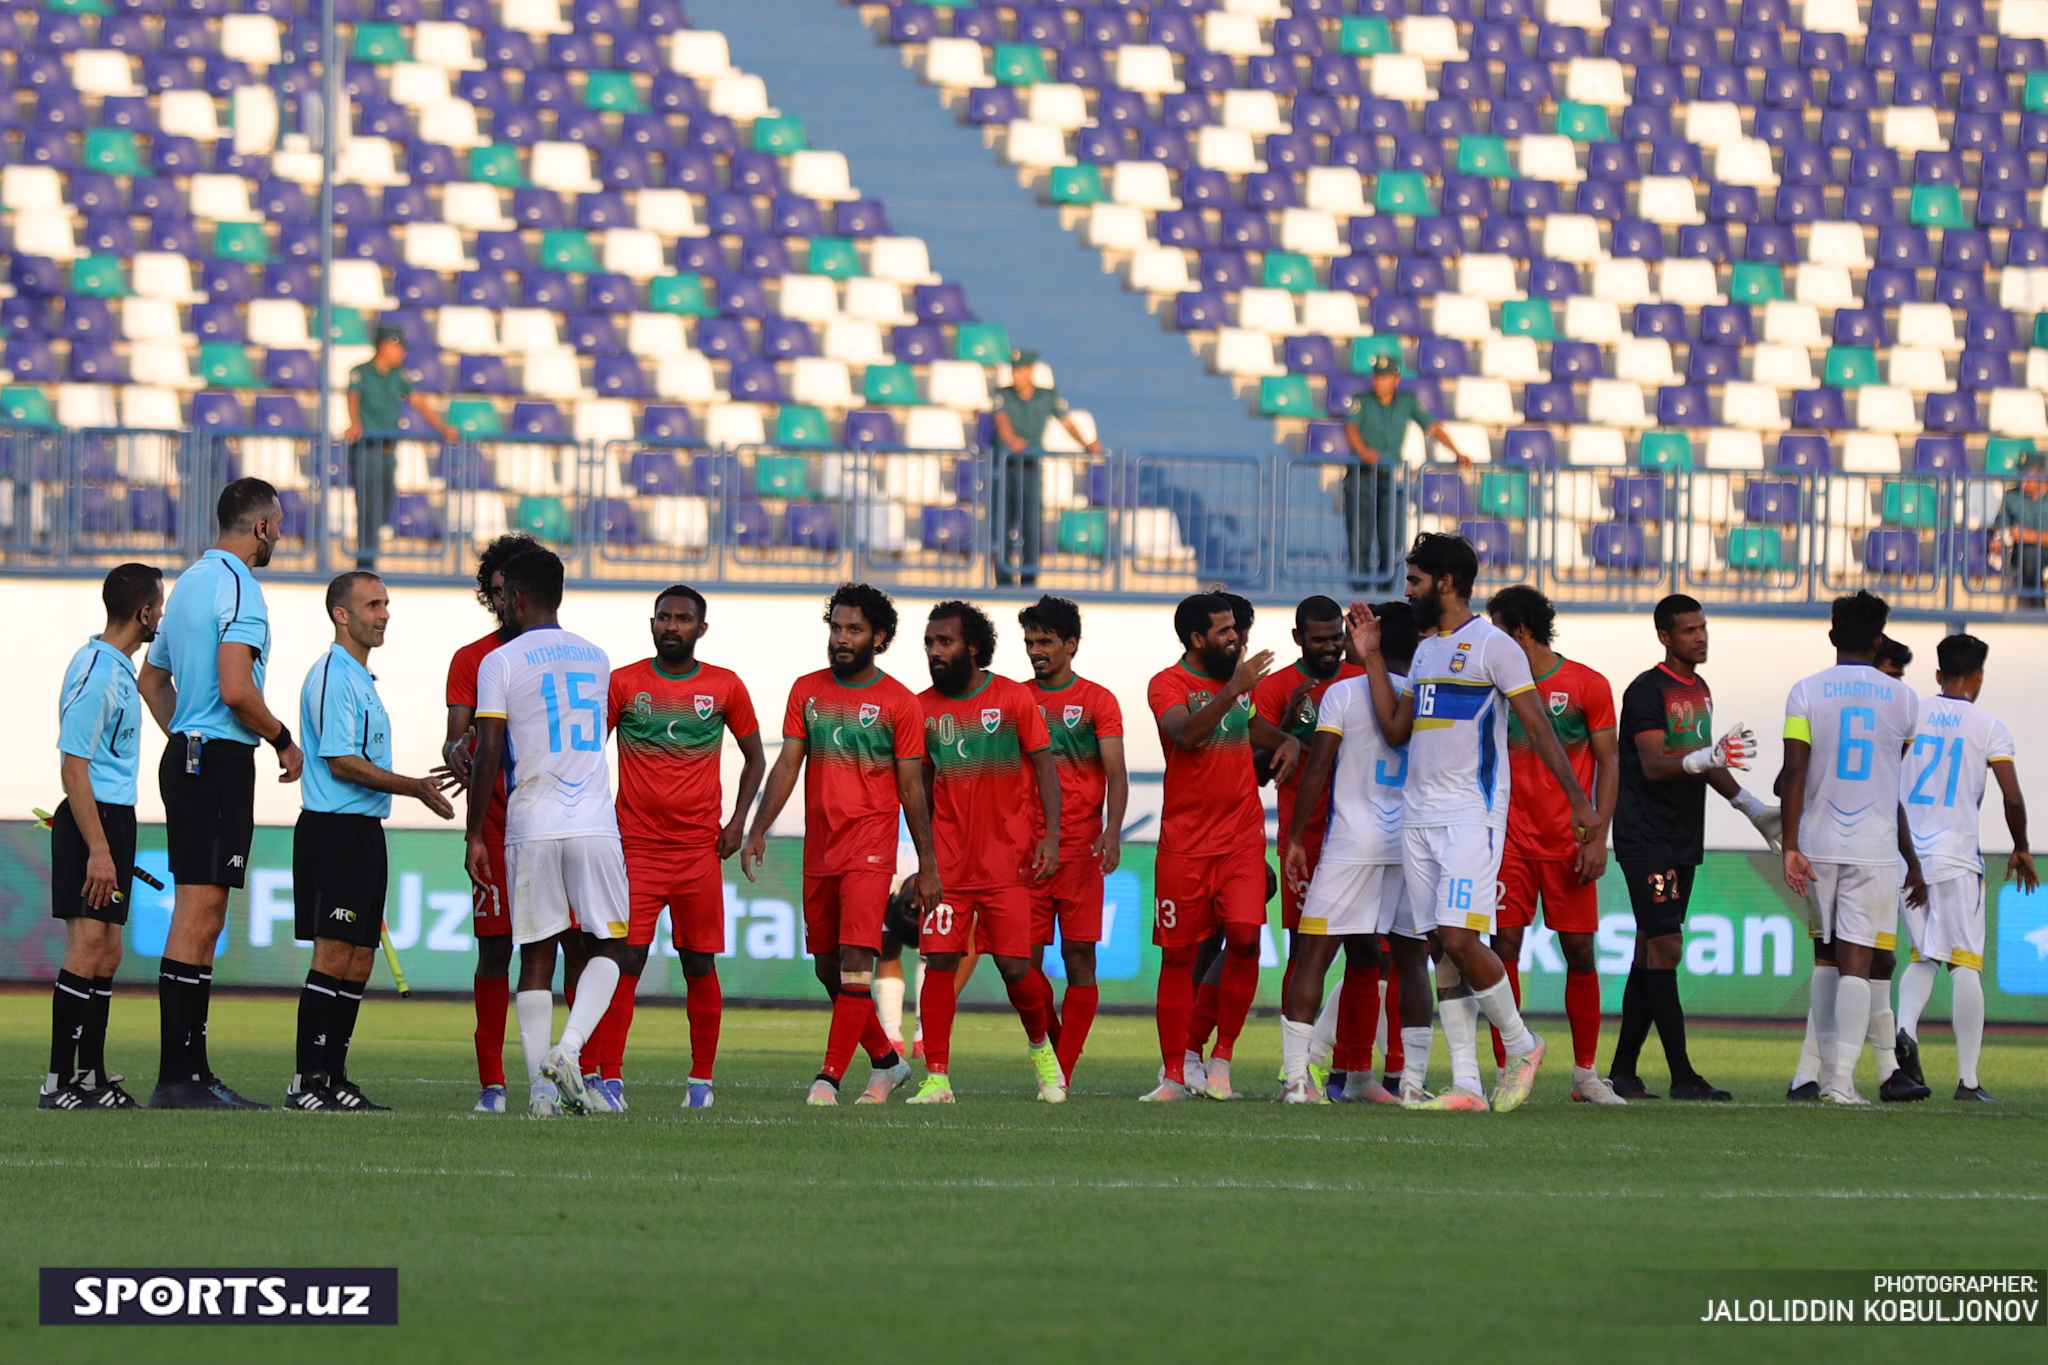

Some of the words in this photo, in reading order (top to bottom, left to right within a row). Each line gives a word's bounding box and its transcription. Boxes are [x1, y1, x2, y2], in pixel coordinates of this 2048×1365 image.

[524, 645, 602, 666] NITHARSHAN
[1418, 684, 1437, 716] 16
[1823, 681, 1893, 701] CHARITHA
[540, 671, 602, 753] 15
[635, 691, 652, 725] 6
[1671, 700, 1697, 732] 22
[1927, 712, 1962, 728] AMAN
[1836, 706, 1876, 782] 6
[1908, 733, 1964, 808] 21
[473, 884, 501, 918] 21
[1447, 878, 1474, 910] 16
[328, 907, 357, 923] AFC
[1155, 897, 1177, 929] 13
